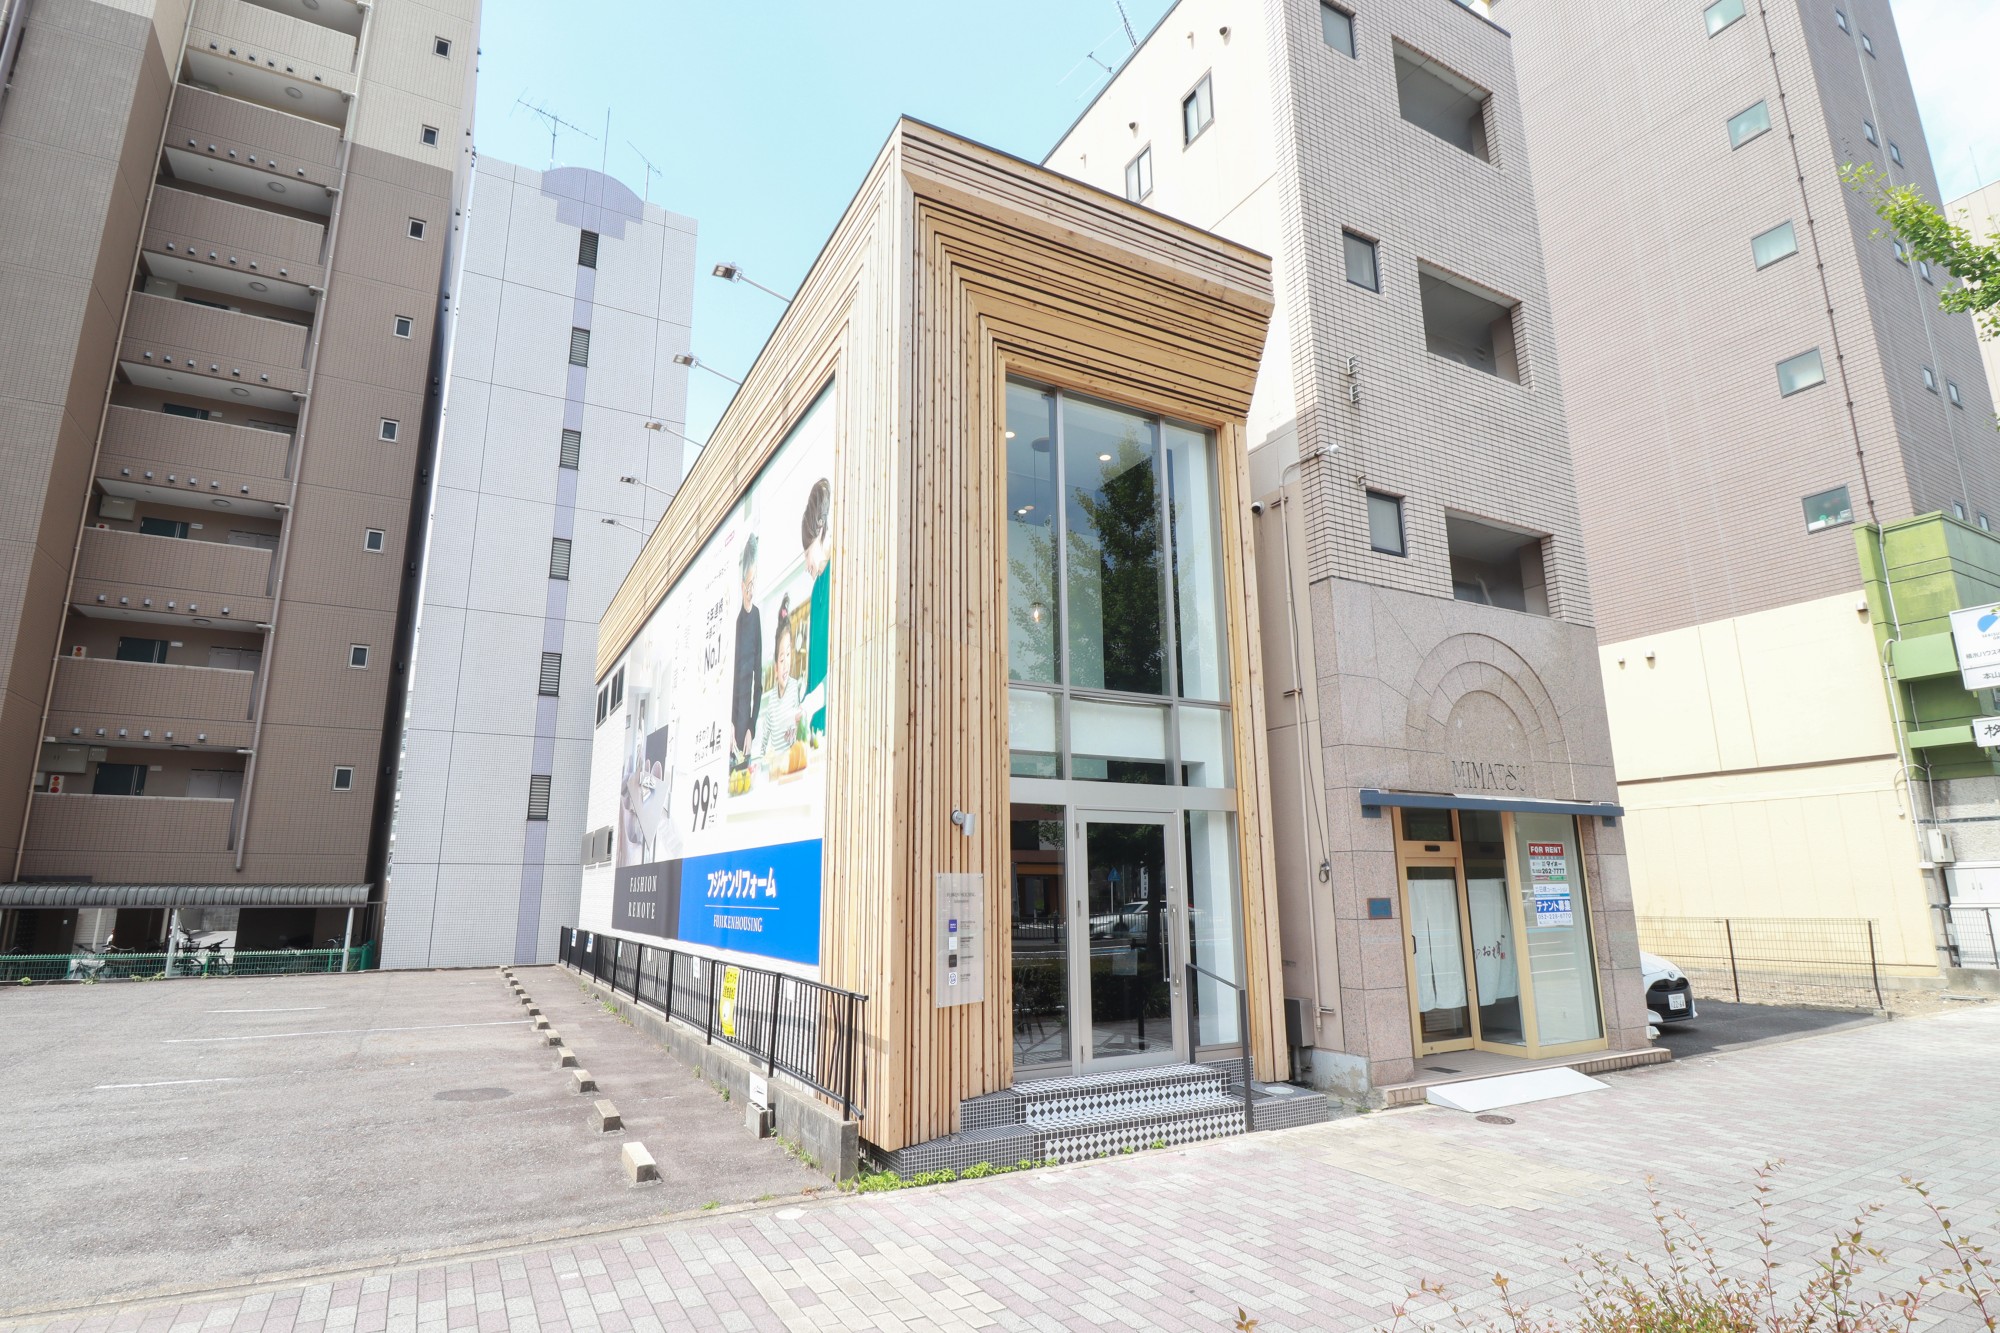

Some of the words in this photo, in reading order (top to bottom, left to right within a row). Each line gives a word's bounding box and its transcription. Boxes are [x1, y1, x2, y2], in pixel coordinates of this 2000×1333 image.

[703, 632, 722, 675] No.1
[1451, 760, 1527, 791] MIMATSU
[691, 775, 719, 833] 99.9
[1530, 846, 1544, 854] FOR
[1545, 846, 1562, 854] RENT
[629, 875, 658, 892] FASHION
[707, 867, 777, 899] フジケンリフォーム
[627, 902, 656, 920] RENOVE
[1536, 899, 1572, 912] テナント募集
